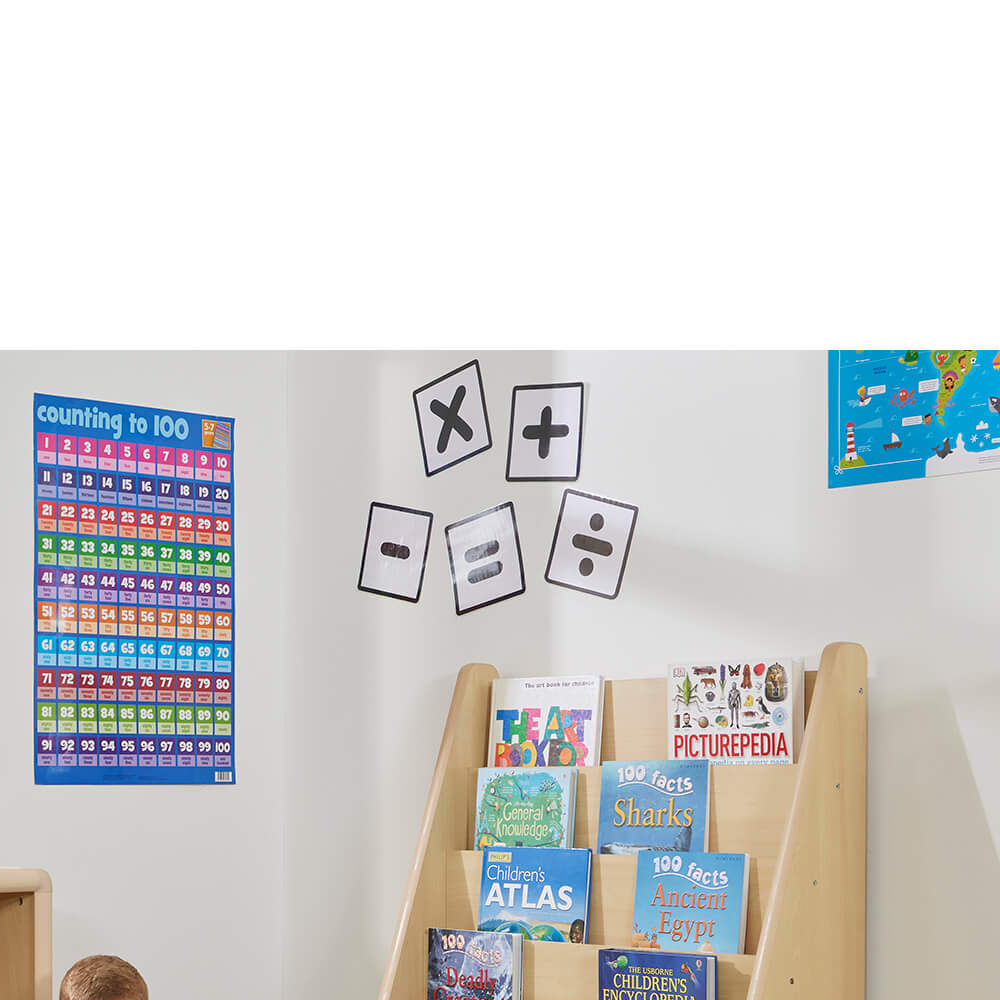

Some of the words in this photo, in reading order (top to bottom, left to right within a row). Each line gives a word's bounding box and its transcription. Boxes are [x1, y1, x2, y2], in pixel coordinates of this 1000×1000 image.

[37, 405, 122, 440] counting
[129, 413, 148, 434] to
[153, 414, 190, 441] 100
[44, 436, 49, 449] 1
[63, 438, 72, 451] 2
[83, 441, 92, 454] 3
[103, 444, 112, 456] 4
[123, 445, 132, 458] 5
[142, 448, 151, 460] 6
[162, 450, 170, 462] 7
[181, 452, 189, 464] 8
[200, 454, 208, 466] 9
[216, 456, 228, 469] 10
[44, 471, 50, 482] 11
[63, 473, 72, 484] 12
[83, 475, 92, 486] 13
[103, 477, 112, 488] 14
[123, 479, 132, 490] 15
[142, 481, 152, 492] 16
[162, 483, 170, 493] 17
[181, 485, 189, 496] 18
[199, 487, 208, 497] 19
[216, 488, 228, 500] 20
[42, 538, 52, 549] 31
[61, 540, 74, 551] 32
[82, 541, 94, 552] 33
[101, 543, 115, 554] 34
[121, 544, 134, 556] 35
[141, 546, 154, 557] 36
[161, 547, 173, 558] 37
[180, 549, 192, 560] 38
[198, 550, 211, 561] 39
[216, 552, 229, 563] 40
[42, 673, 51, 683] 71
[61, 673, 74, 684] 72
[81, 674, 94, 685] 73
[102, 675, 113, 685] 74
[121, 676, 133, 686] 75
[141, 677, 153, 687] 76
[160, 677, 172, 687] 77
[180, 678, 191, 688] 78
[198, 679, 210, 688] 79
[216, 679, 229, 689] 80
[496, 708, 541, 744] THE
[544, 706, 592, 742] ART
[42, 740, 52, 750] 91
[61, 740, 74, 751] 92
[81, 740, 95, 751] 93
[101, 741, 115, 751] 94
[121, 741, 135, 752] 95
[141, 741, 154, 751] 96
[161, 741, 173, 751] 97
[179, 742, 193, 752] 98
[199, 742, 211, 752] 99
[216, 742, 230, 752] 100
[494, 739, 550, 767] BOOK
[674, 732, 788, 758] PICTUREPEDIA
[617, 765, 646, 782] 100
[651, 770, 693, 792] facts
[503, 802, 544, 820] General
[613, 797, 694, 827] Sharks
[496, 818, 549, 840] Knowledge
[487, 865, 544, 882] Children's
[653, 855, 682, 873] 100
[687, 862, 728, 885] facts
[485, 882, 573, 911] ATLAS
[651, 883, 728, 910] Ancient
[658, 910, 716, 943] Egypt
[441, 934, 465, 950] 100
[469, 942, 502, 963] facts
[445, 966, 497, 996] Deadly
[613, 973, 687, 994] CHILDREN'S
[628, 966, 641, 974] THE
[642, 967, 673, 976] USBORNE
